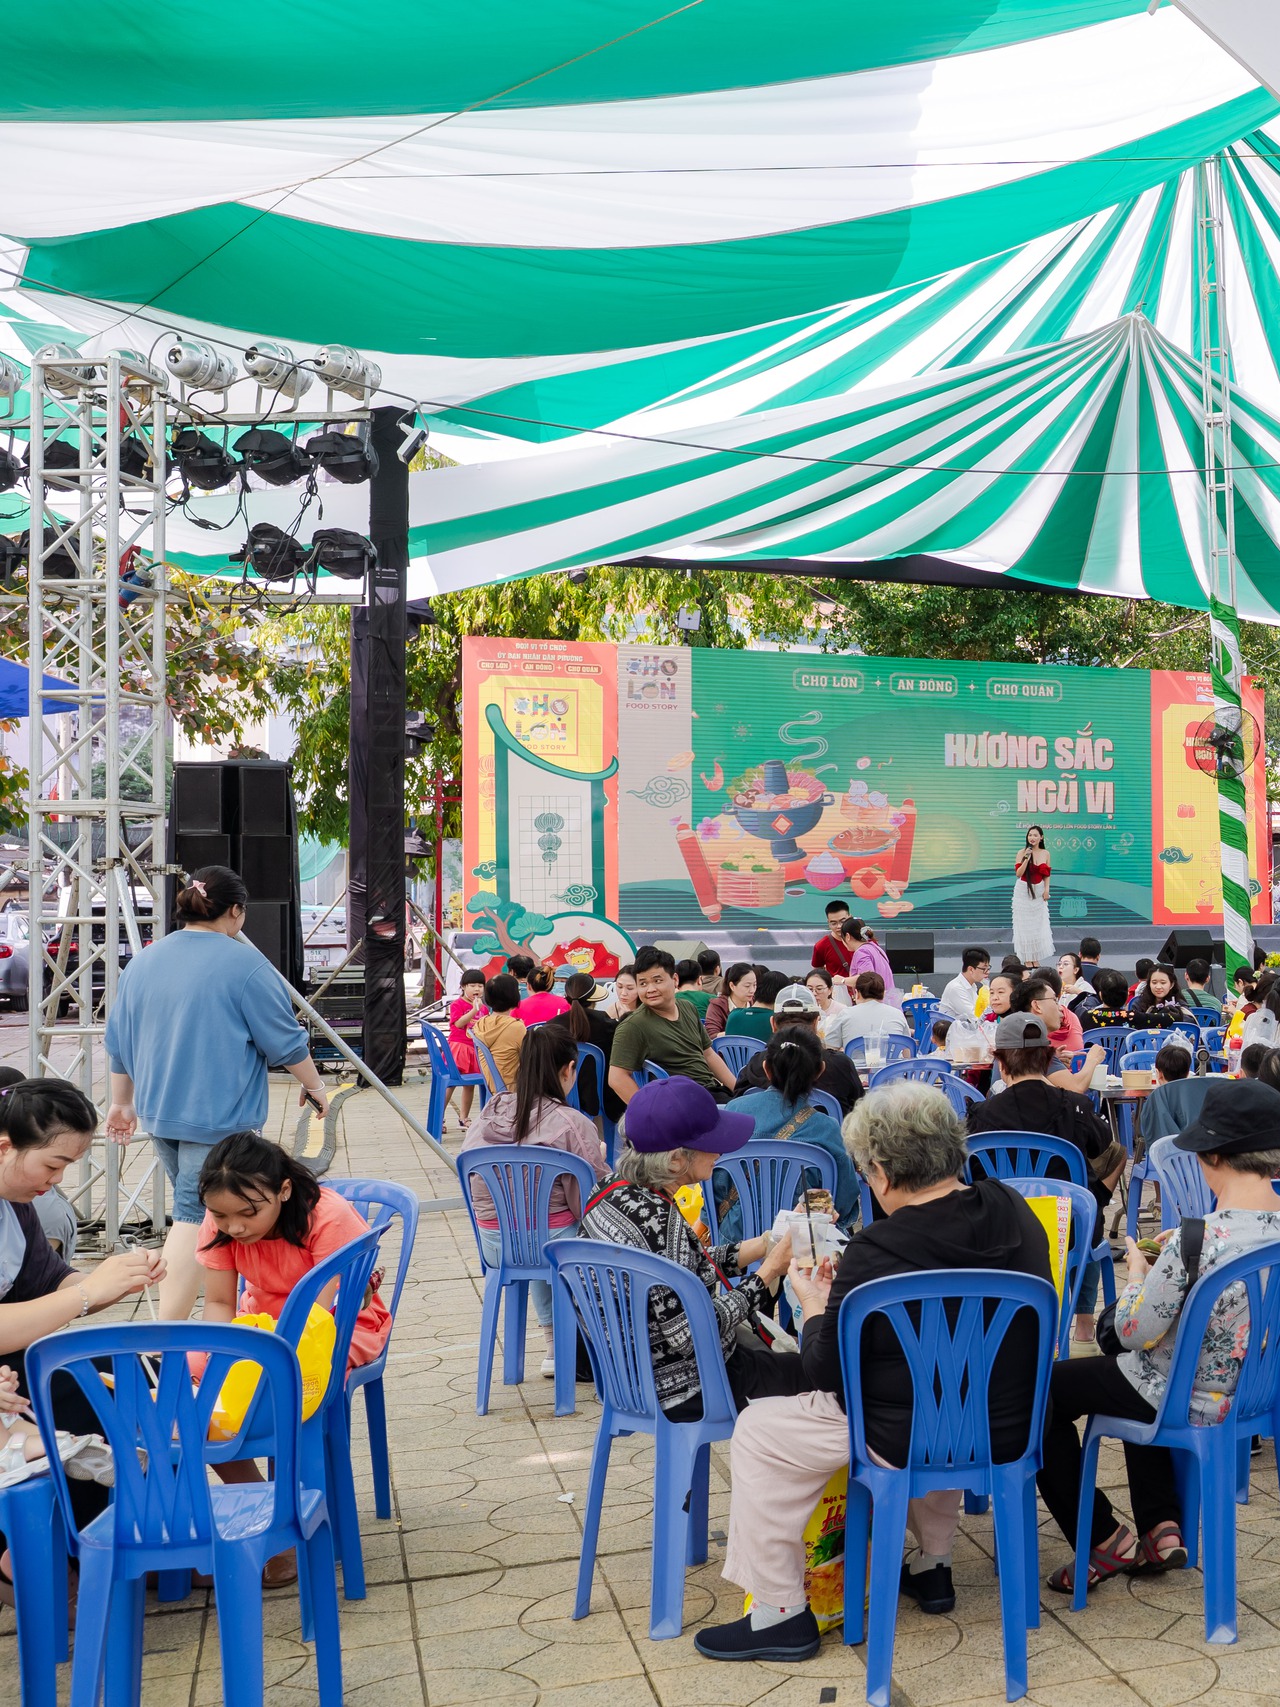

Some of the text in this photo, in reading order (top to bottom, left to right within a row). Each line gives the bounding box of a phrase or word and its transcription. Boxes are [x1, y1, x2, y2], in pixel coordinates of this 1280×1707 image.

[801, 673, 858, 690] CHỢ LỚN
[898, 676, 954, 692] AN ĐÔNG
[994, 682, 1054, 698] CHỢ QUÁN
[944, 721, 1114, 771] HƯƠNG SẮC
[1017, 772, 1115, 821] NGŨ VỊ
